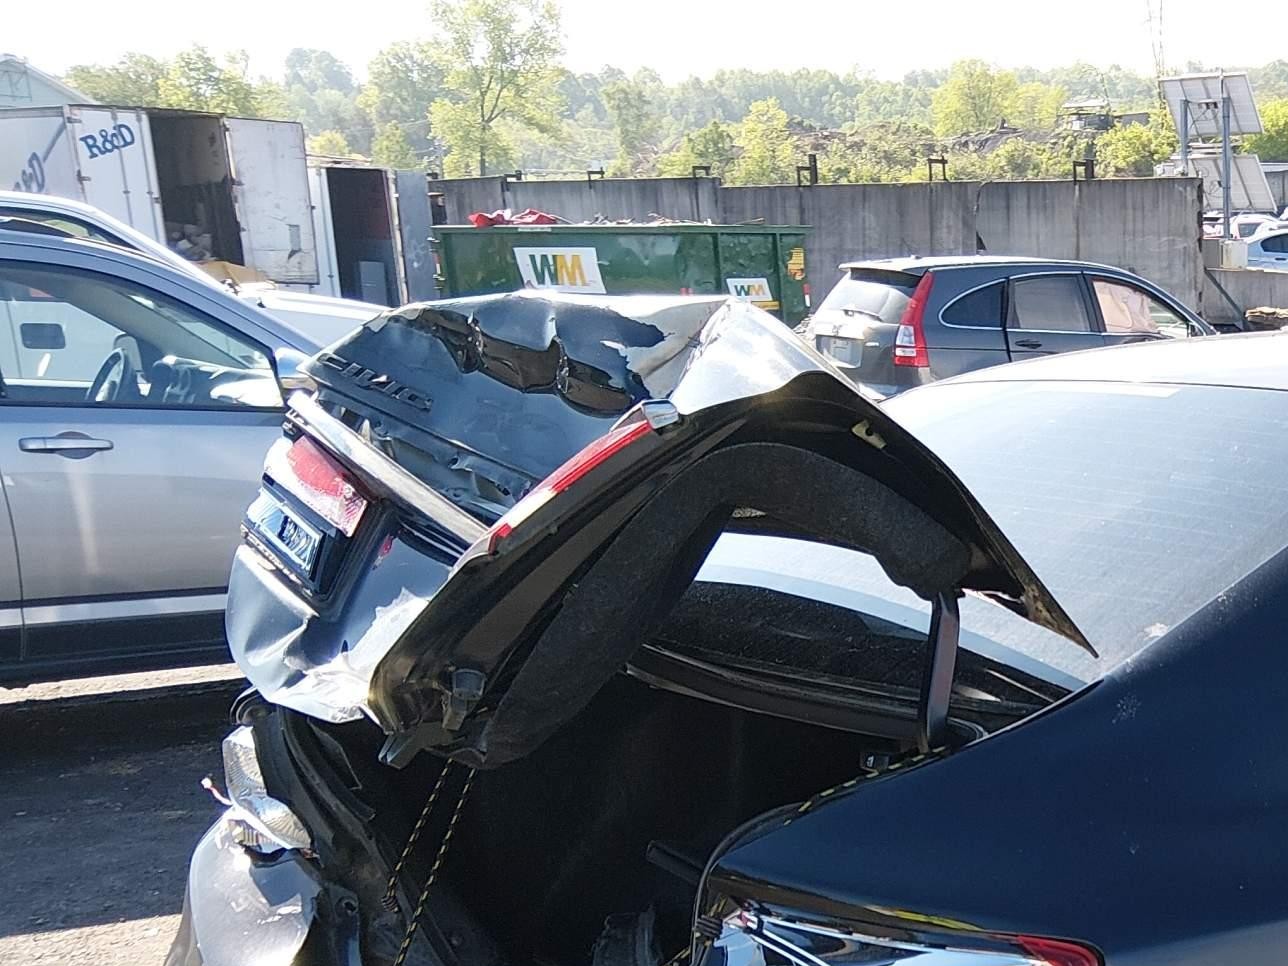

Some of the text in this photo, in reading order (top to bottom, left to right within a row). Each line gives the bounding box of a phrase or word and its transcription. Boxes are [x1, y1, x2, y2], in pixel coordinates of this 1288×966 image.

[79, 123, 135, 159] R&D
[528, 253, 587, 286] WM
[734, 284, 766, 297] WM
[317, 352, 433, 412] CIVIC
